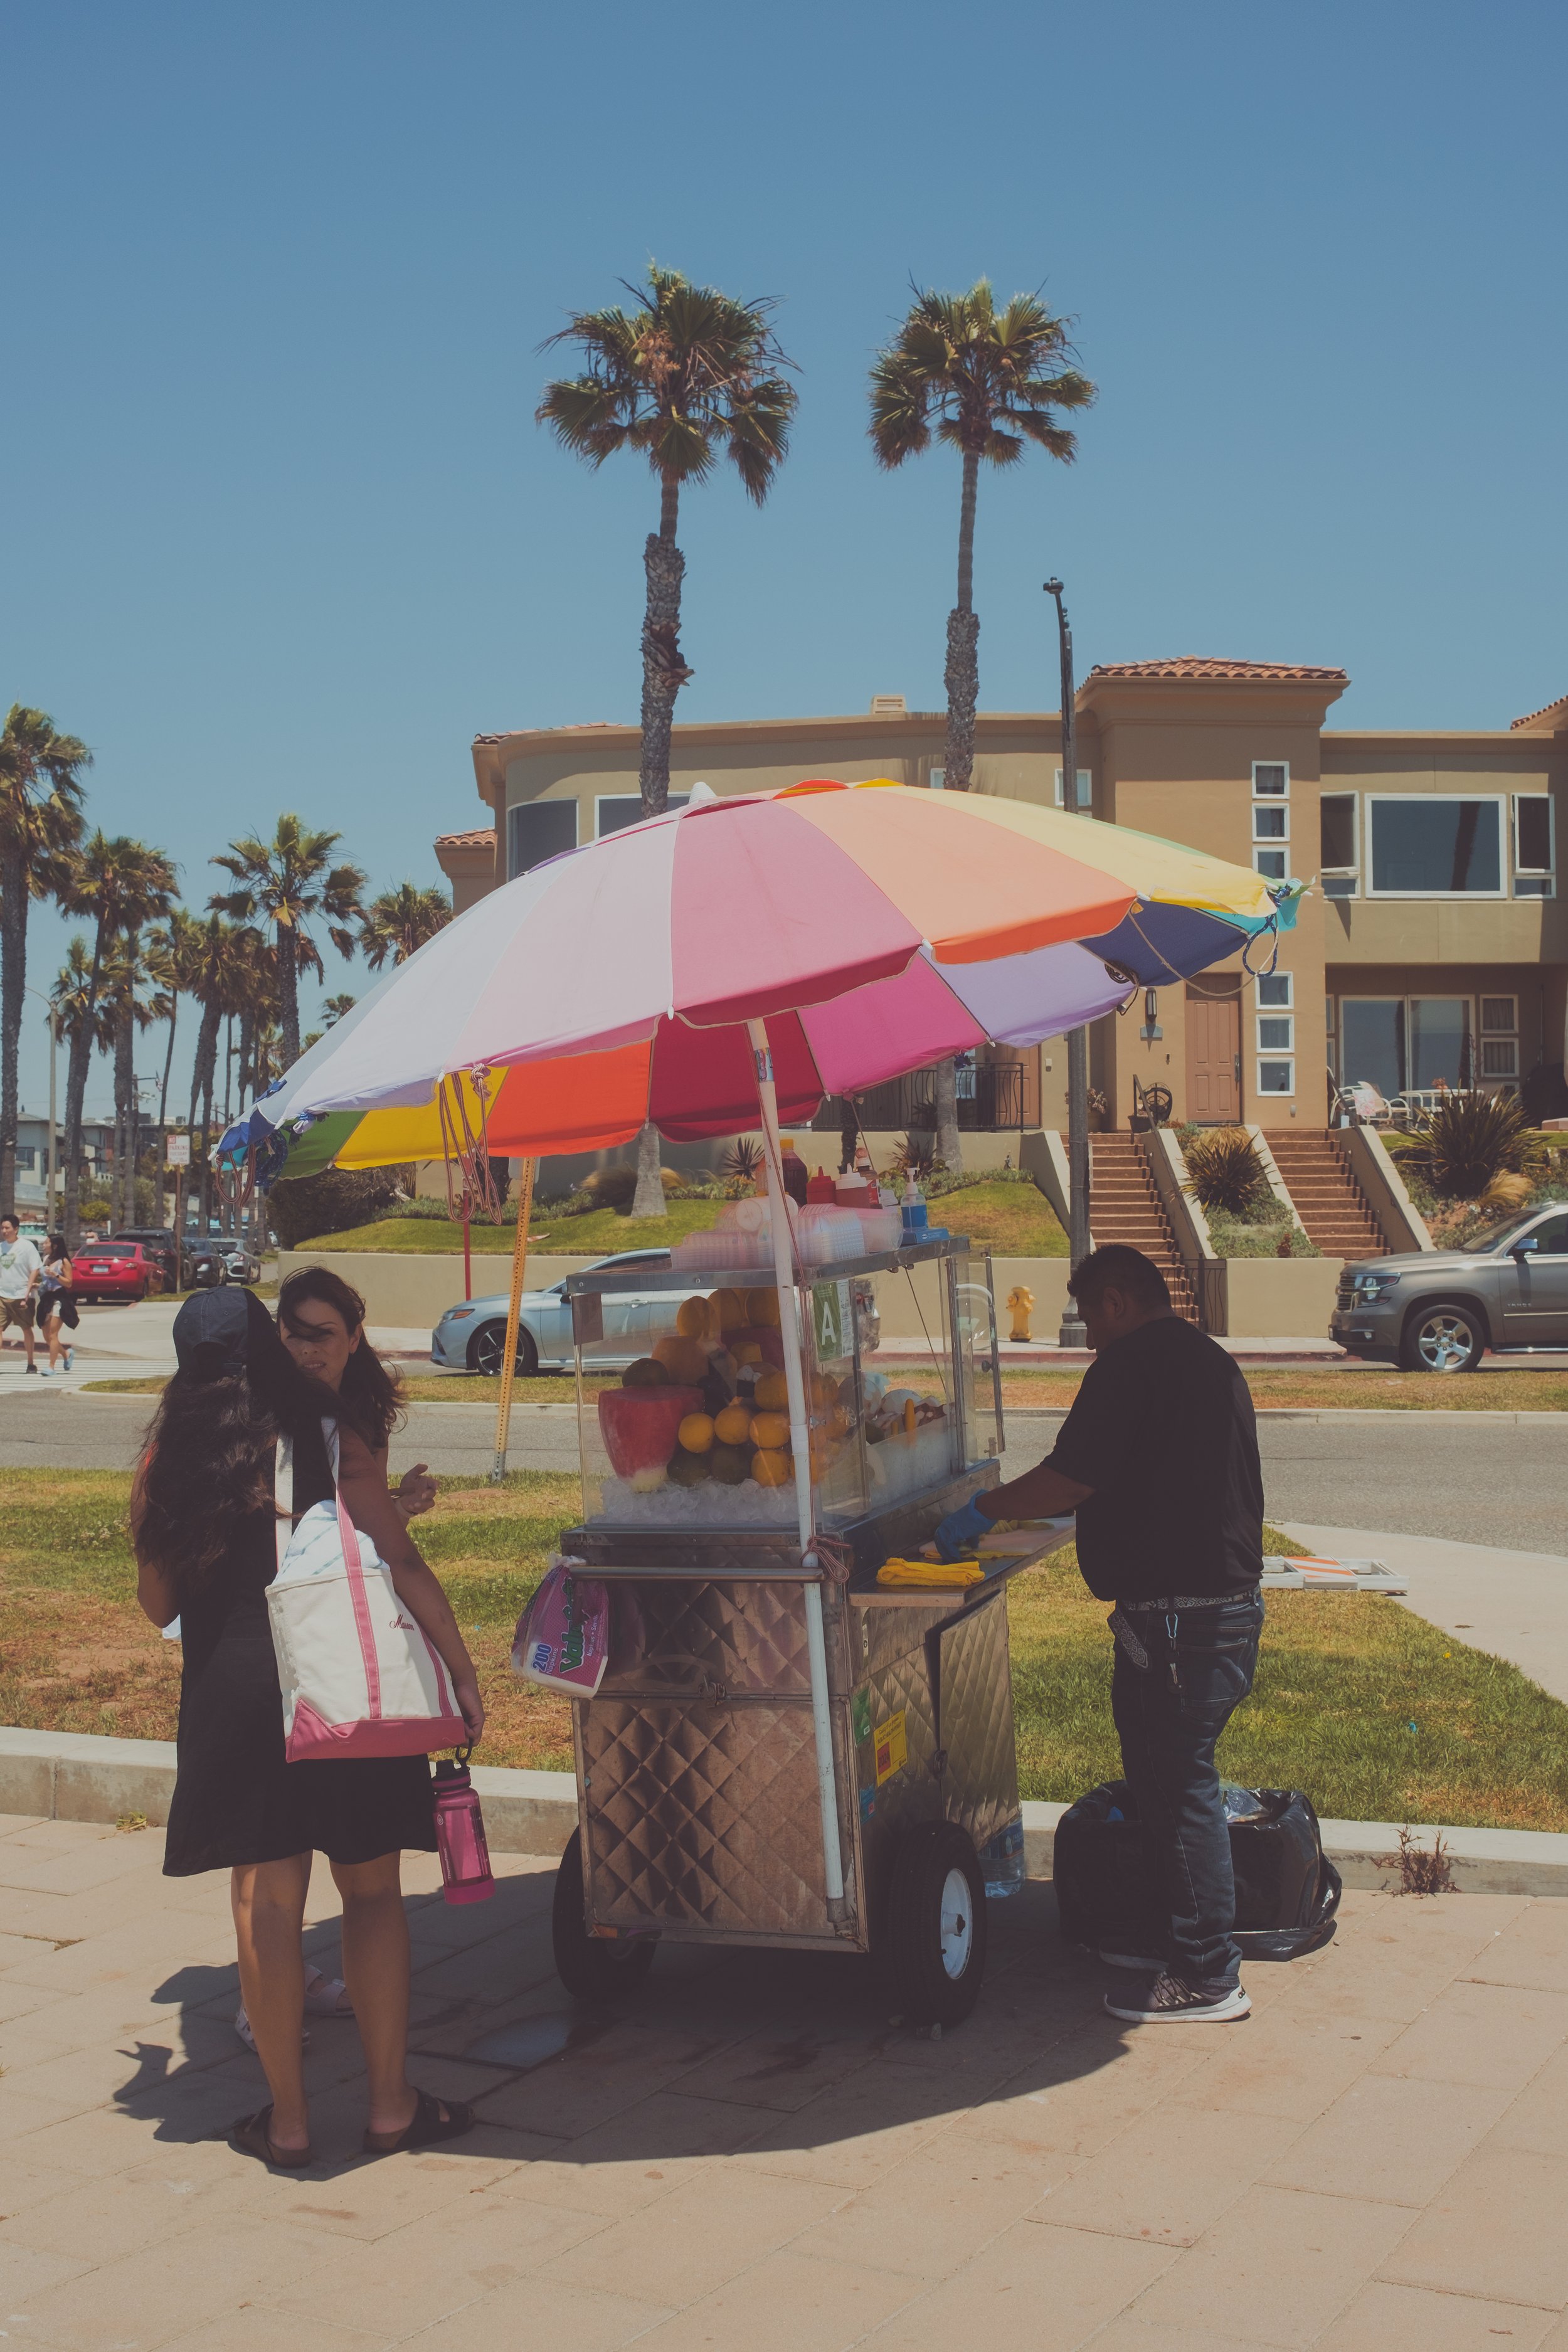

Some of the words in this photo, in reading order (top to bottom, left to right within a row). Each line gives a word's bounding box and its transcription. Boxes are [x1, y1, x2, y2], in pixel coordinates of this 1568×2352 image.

[821, 1301, 837, 1346] A
[532, 1643, 552, 1672] 200
[546, 1648, 559, 1675] Napkins
[443, 1848, 452, 1880] ThermoFlask
